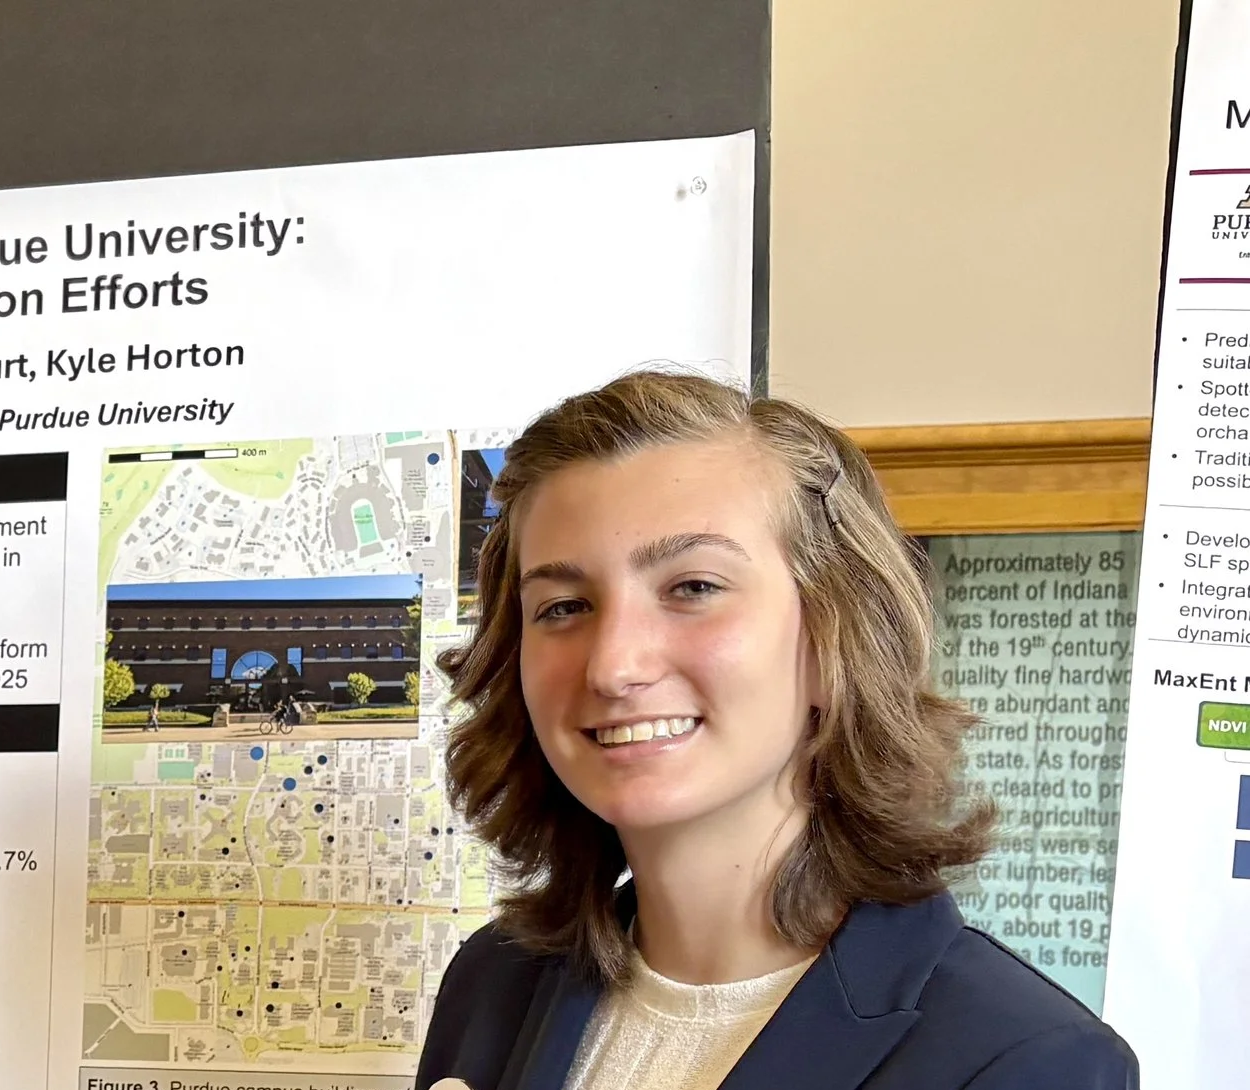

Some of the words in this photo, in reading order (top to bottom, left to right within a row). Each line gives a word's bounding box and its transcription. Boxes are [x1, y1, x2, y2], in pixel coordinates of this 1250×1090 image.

[65, 212, 304, 261] University:
[61, 271, 209, 314] Efforts
[47, 347, 116, 382] Kyle
[127, 343, 244, 372] Horton
[98, 397, 235, 426] University
[241, 448, 257, 457] 400
[945, 553, 1092, 577] Approximately
[1099, 551, 1125, 571] 85
[1184, 553, 1222, 569] SLF
[1026, 580, 1047, 601] of
[1054, 580, 1128, 600] Indiana
[990, 609, 1072, 629] forested
[1079, 610, 1098, 628] at
[1105, 609, 1136, 628] the
[1154, 669, 1237, 692] MaxEnt
[1208, 719, 1247, 734] NDVI
